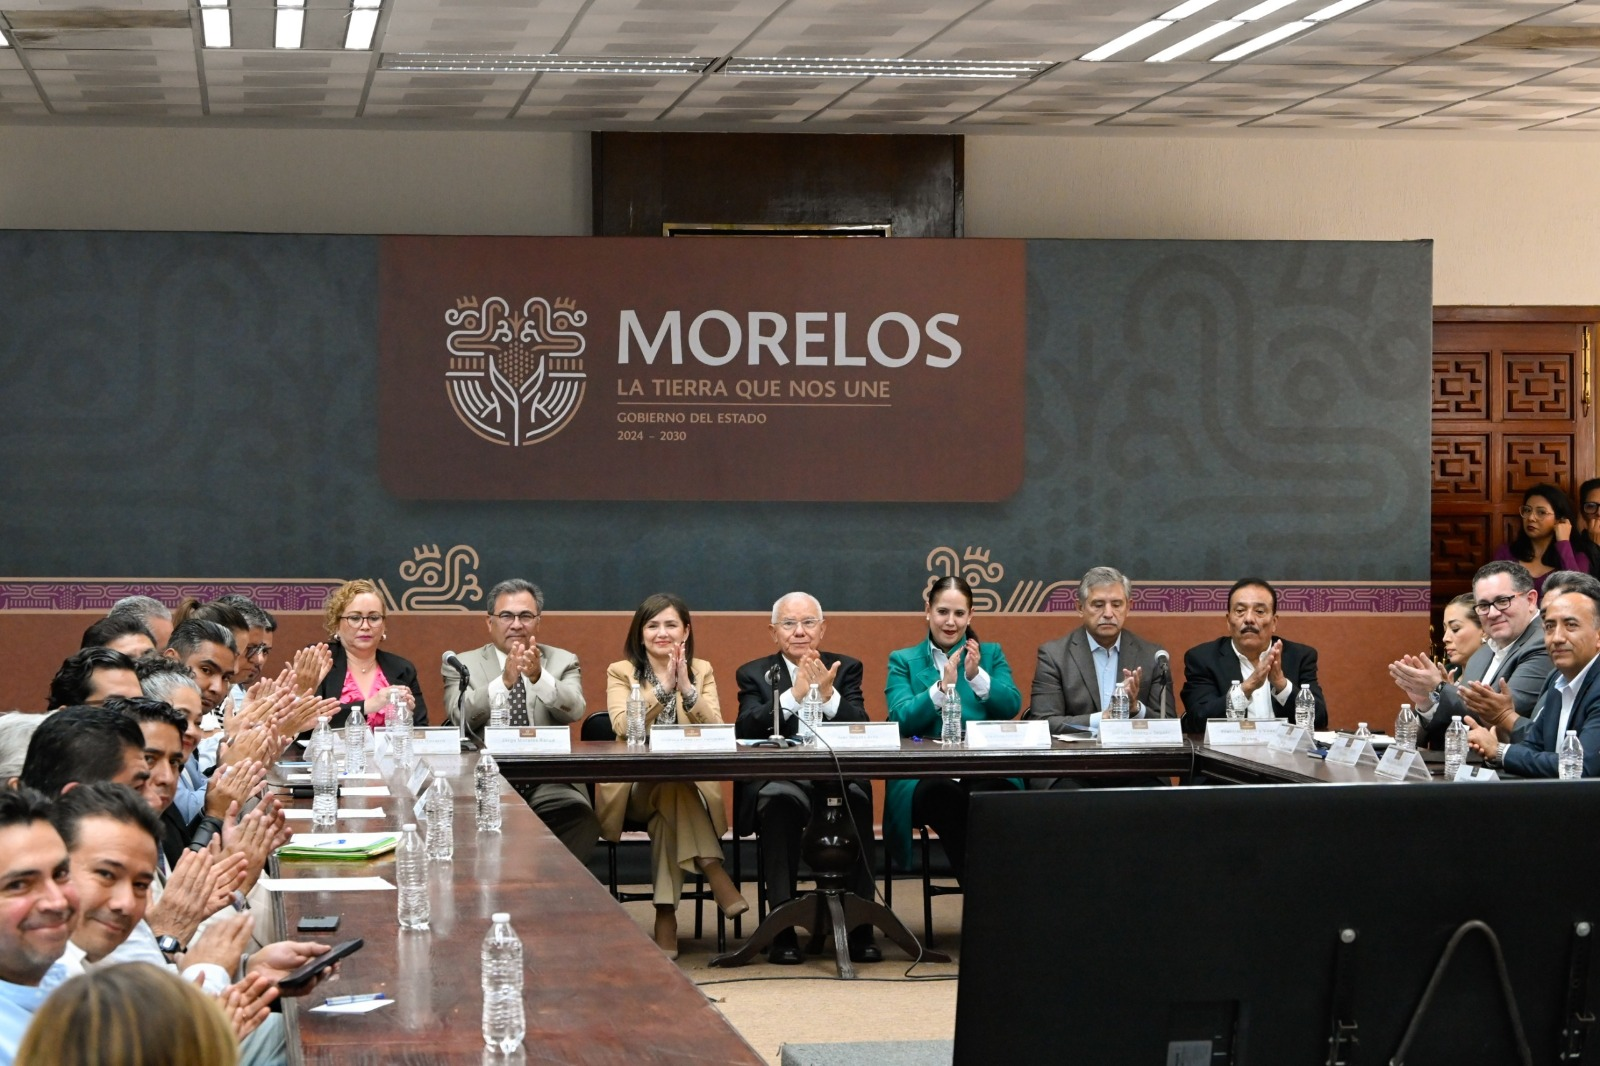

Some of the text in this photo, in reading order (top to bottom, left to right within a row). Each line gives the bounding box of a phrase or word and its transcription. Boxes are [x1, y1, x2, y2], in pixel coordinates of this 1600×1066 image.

[618, 310, 961, 368] MORELOS
[618, 379, 890, 399] LA TIERRA QUE NOS UNE
[617, 413, 766, 423] GOBIERNO DEL ESTADO
[618, 431, 643, 440] 2024
[660, 431, 686, 440] 2030
